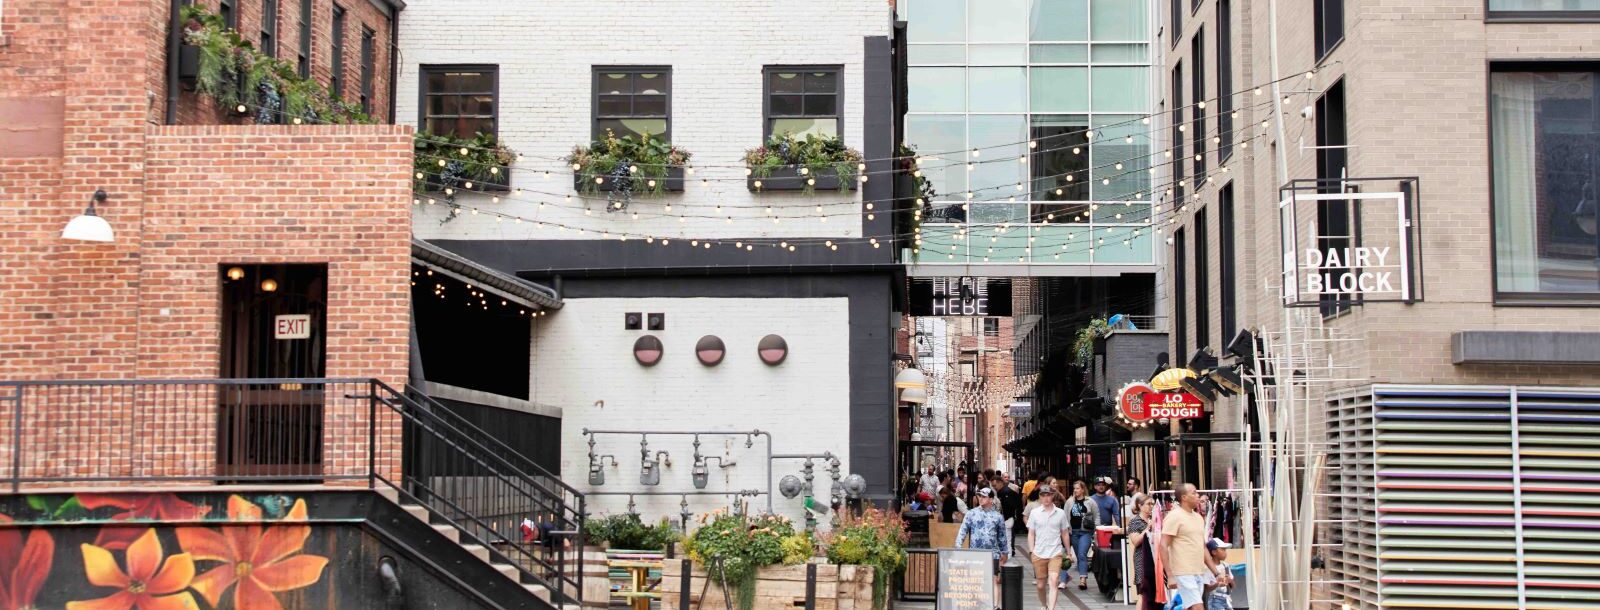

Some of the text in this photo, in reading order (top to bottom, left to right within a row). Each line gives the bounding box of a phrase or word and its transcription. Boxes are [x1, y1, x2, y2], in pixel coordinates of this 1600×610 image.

[1306, 246, 1391, 268] DAIRY
[1307, 271, 1393, 293] BLOCK
[278, 319, 307, 335] EXIT
[1165, 394, 1183, 403] LO
[1151, 407, 1199, 417] DOUGH
[948, 568, 968, 576] STATE
